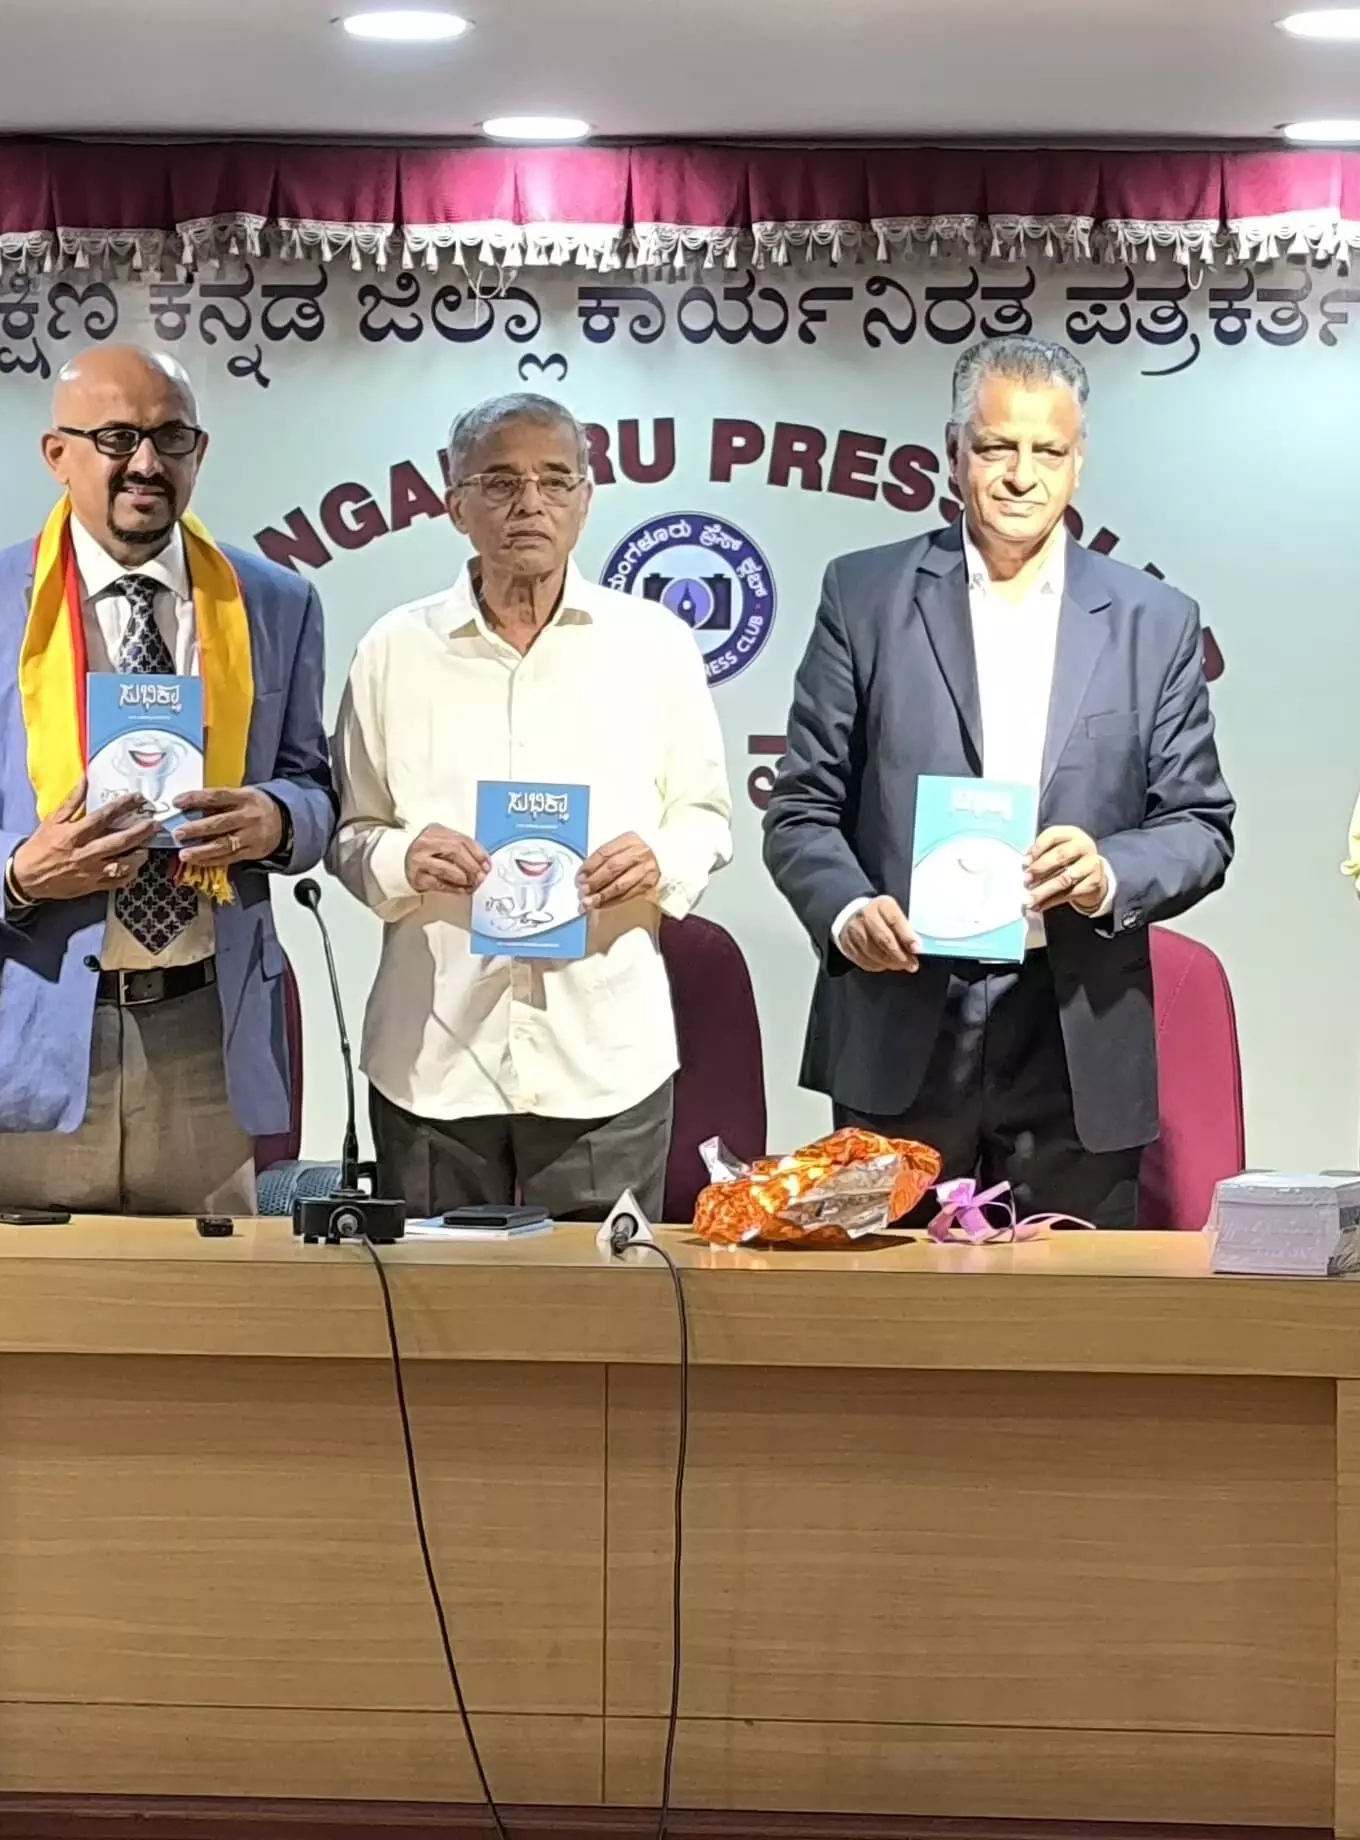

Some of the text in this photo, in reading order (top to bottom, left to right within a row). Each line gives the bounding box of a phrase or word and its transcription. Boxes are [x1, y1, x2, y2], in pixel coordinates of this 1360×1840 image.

[149, 263, 328, 388] ಕನ್ನಡ
[358, 270, 568, 382] ಜಿಲ್ಲಾ
[253, 417, 676, 576] NGARU
[705, 615, 764, 678] RESS CLUB
